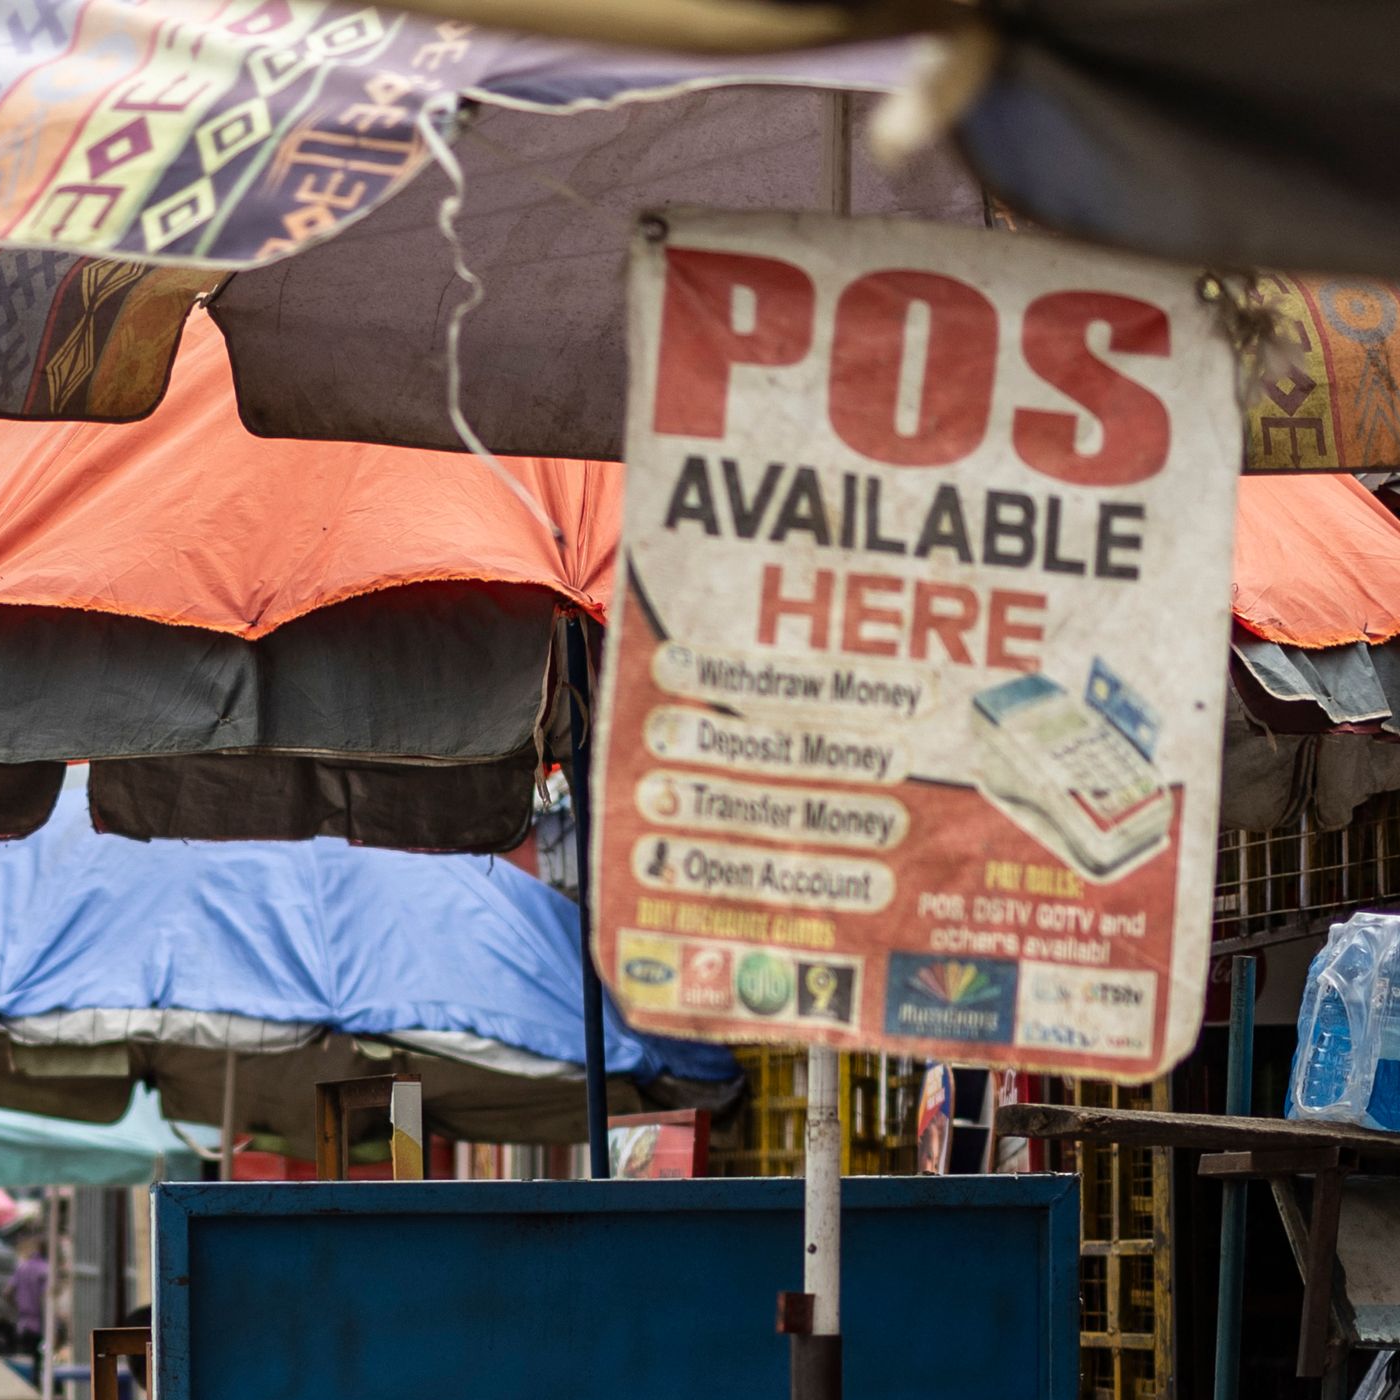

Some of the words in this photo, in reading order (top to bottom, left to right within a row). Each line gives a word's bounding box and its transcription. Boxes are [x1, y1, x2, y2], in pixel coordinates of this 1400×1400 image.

[653, 247, 1170, 486] POS
[665, 455, 1146, 579] AVAILABLE
[758, 564, 1048, 672] HERE
[699, 655, 823, 697] Withdraw
[833, 671, 922, 716] Money
[699, 719, 793, 764] Deposit
[803, 734, 894, 779] Money
[691, 783, 795, 827] Transfer
[805, 800, 894, 845] Money
[684, 849, 754, 889] Open
[761, 861, 872, 903] Account
[930, 926, 1020, 956] others
[1099, 911, 1147, 938] and
